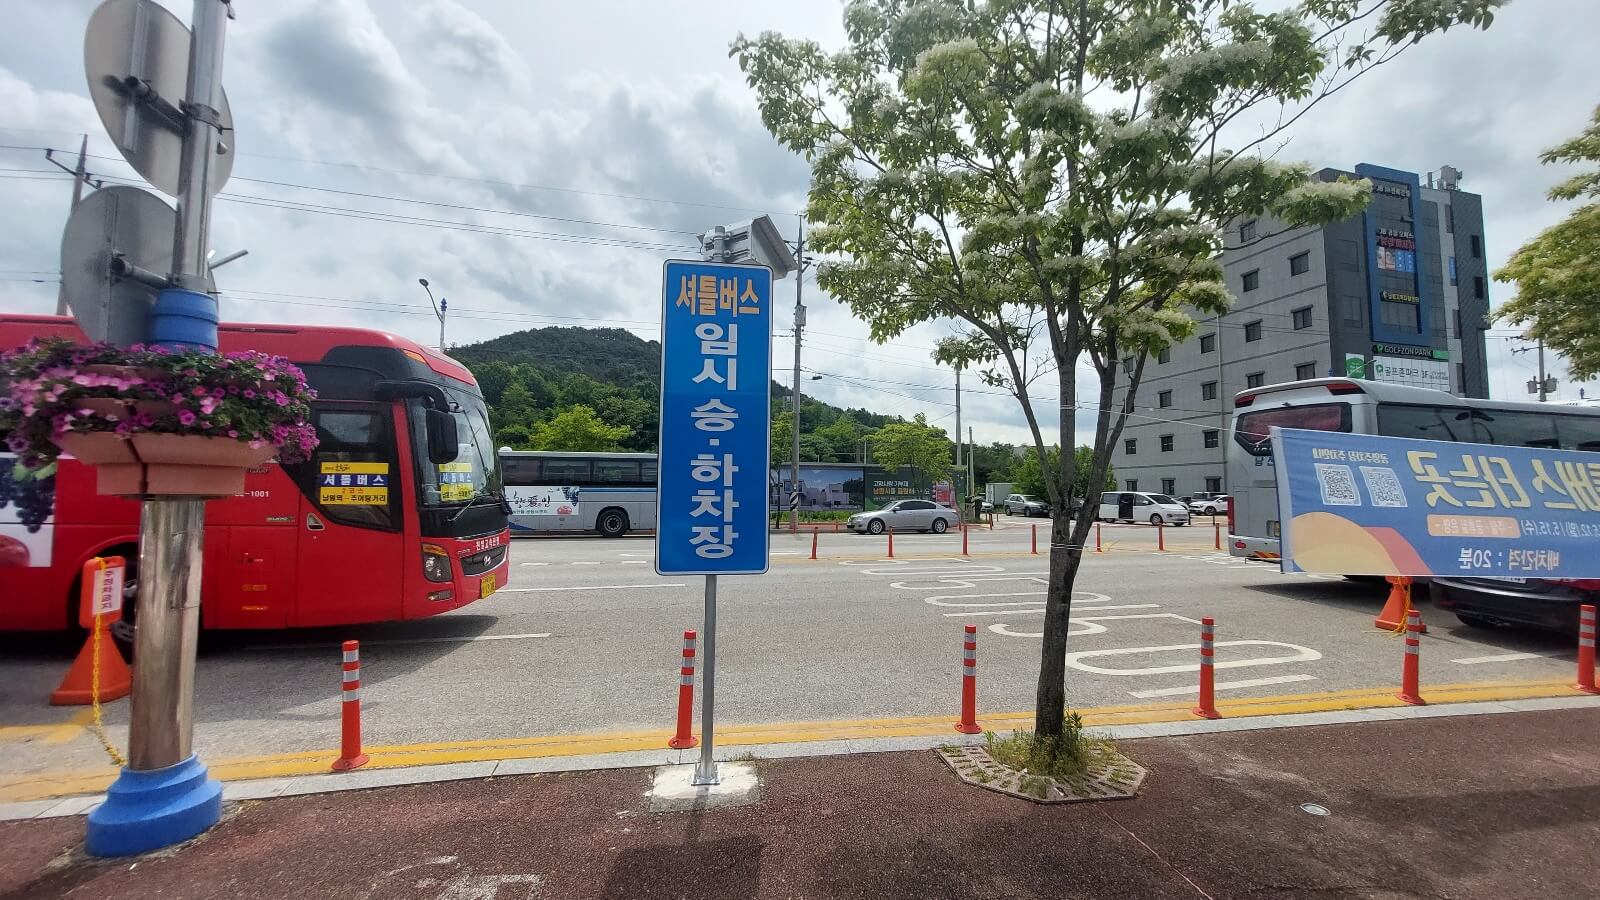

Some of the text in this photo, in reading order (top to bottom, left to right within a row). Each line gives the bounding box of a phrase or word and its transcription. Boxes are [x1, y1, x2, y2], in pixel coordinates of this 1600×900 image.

[675, 273, 761, 317] 셔틀버스
[691, 322, 738, 391] 임시
[1385, 366, 1419, 378] 골프존파크
[324, 474, 385, 486] 셔틀버스
